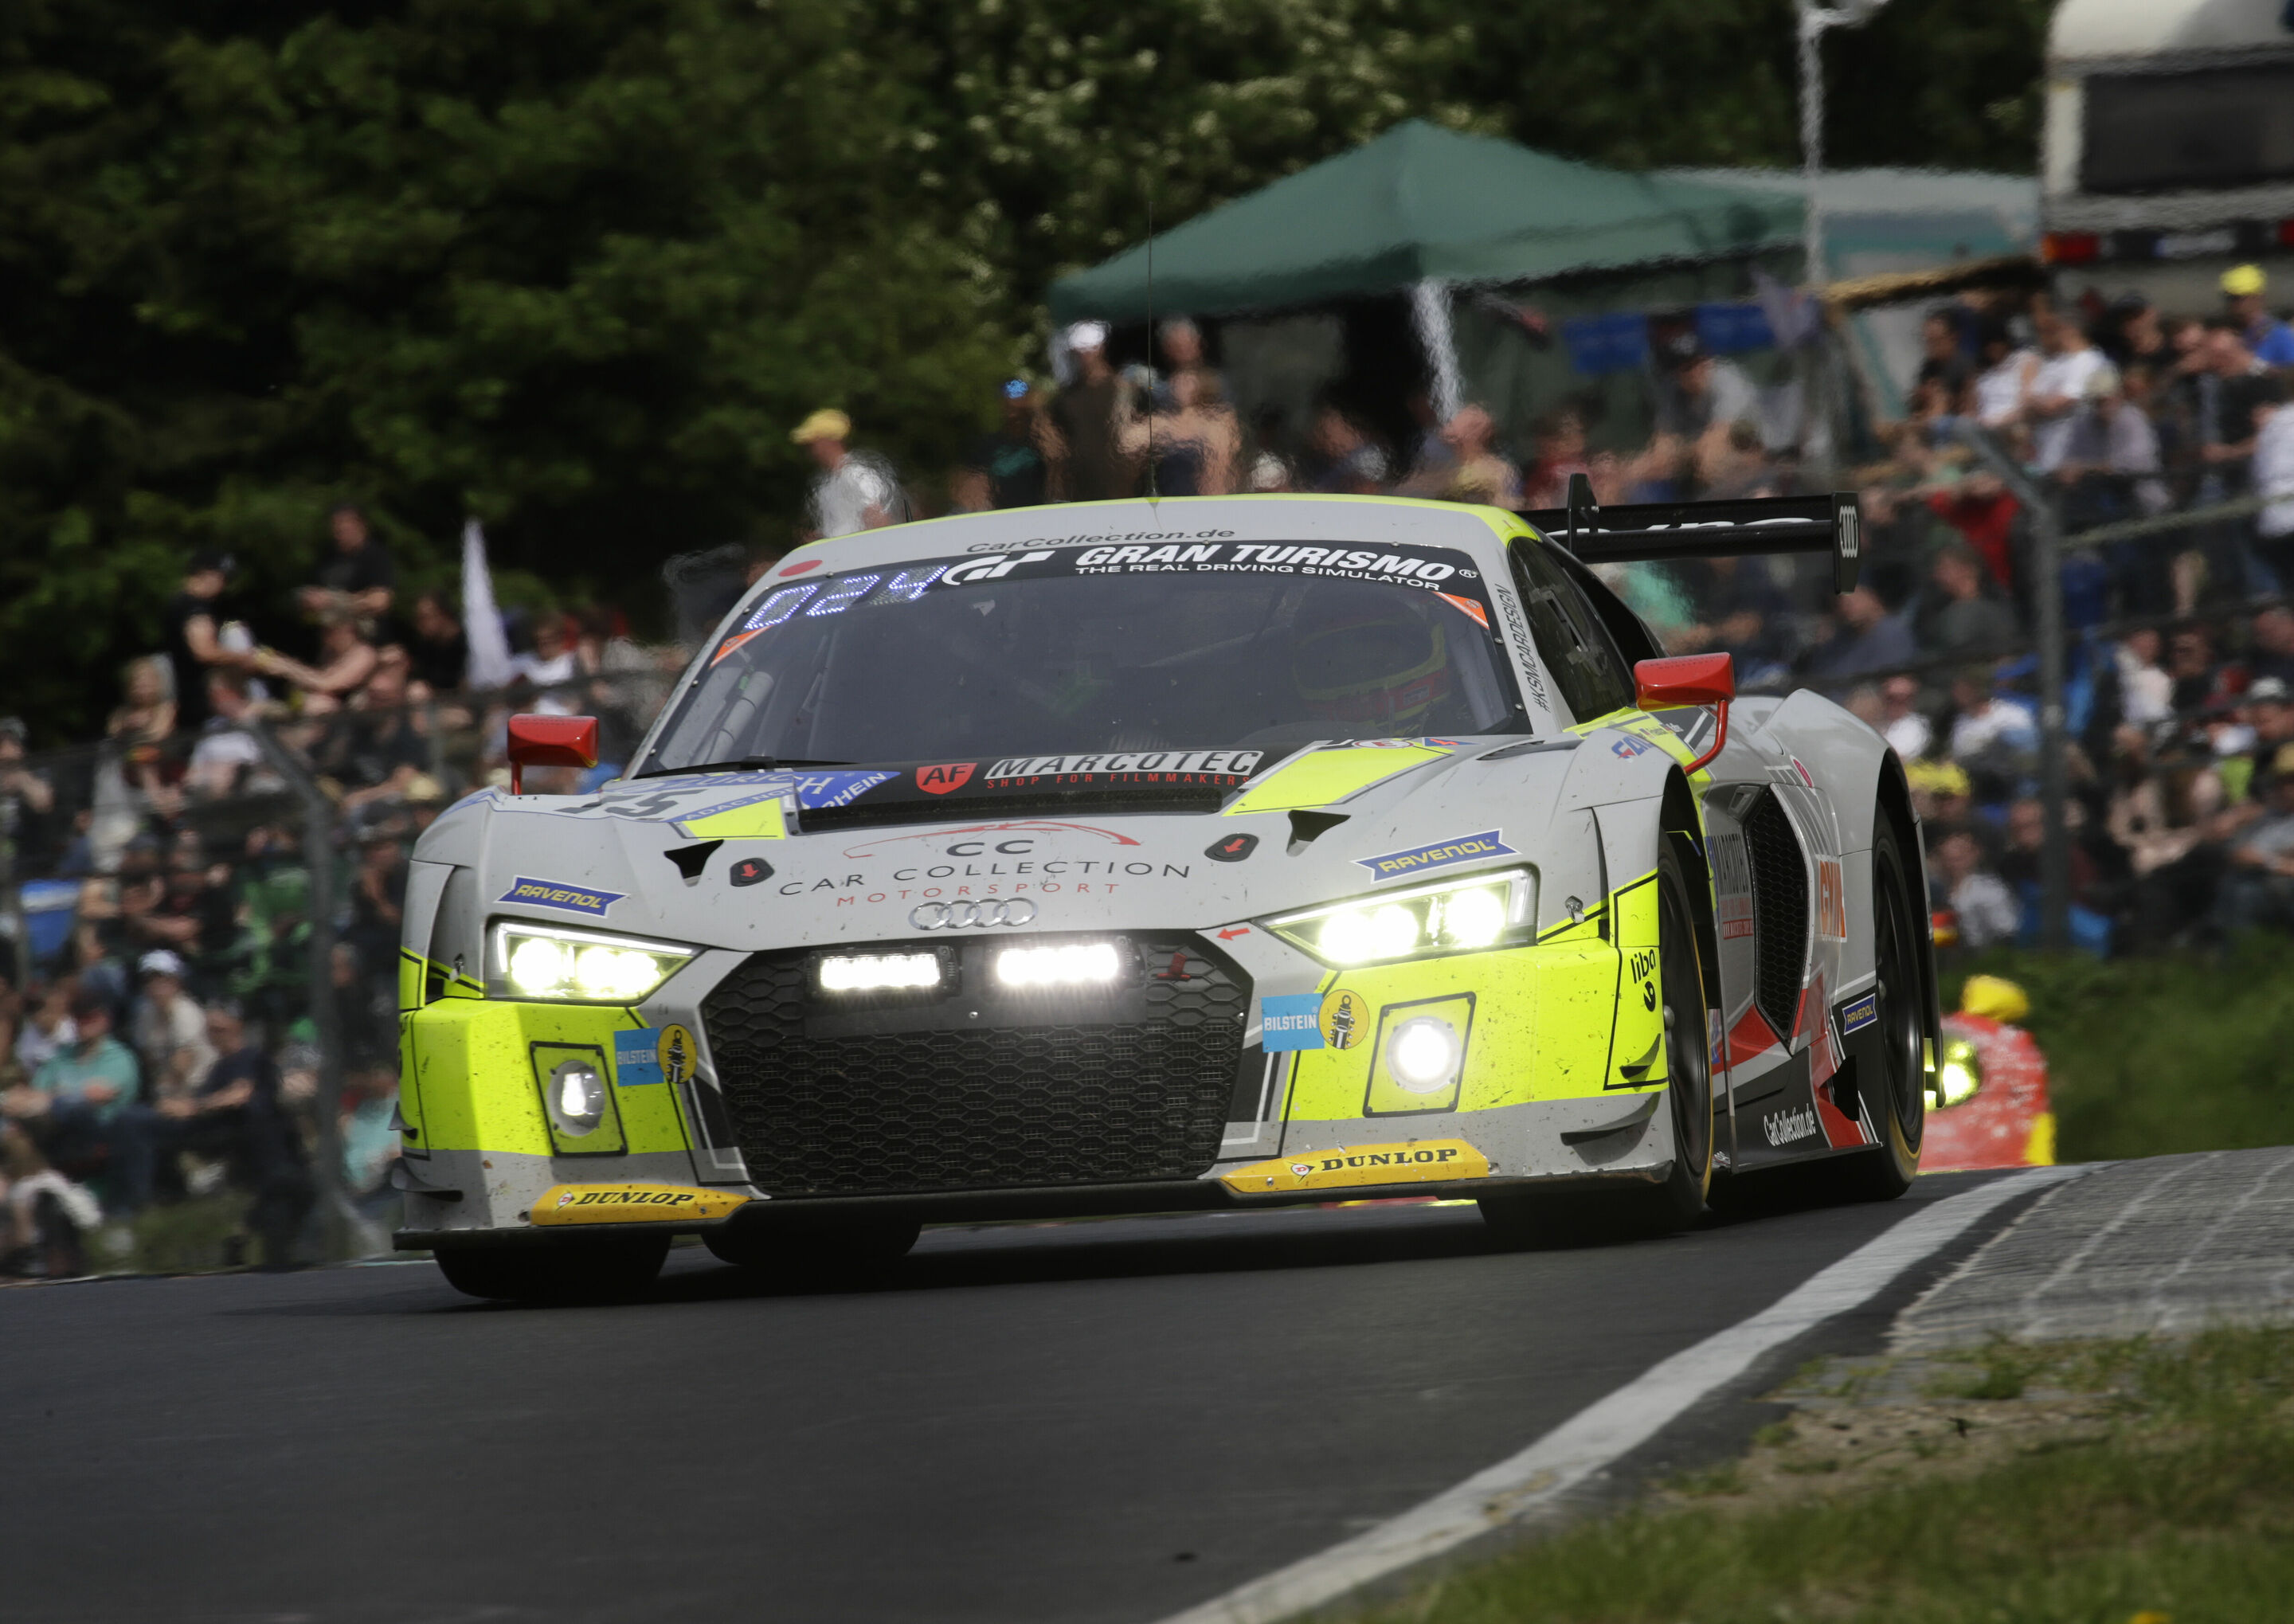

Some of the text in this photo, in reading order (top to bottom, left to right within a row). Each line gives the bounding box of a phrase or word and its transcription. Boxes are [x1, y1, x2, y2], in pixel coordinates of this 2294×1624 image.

[966, 529, 1235, 552] CarCollection.de
[1075, 545, 1455, 581] GRAN TURISMO
[1075, 563, 1441, 591] THE REAL DRIVING SIMULATOR
[922, 765, 969, 786] AF
[991, 751, 1260, 777] MARCOTEC
[987, 777, 1039, 789] SHOP
[1056, 774, 1093, 784] FOR
[686, 800, 747, 820] ADAC
[946, 840, 1035, 857] CC
[1379, 838, 1497, 872] RAVENOL
[779, 861, 1190, 896] CAR COLLECTION
[515, 883, 603, 910] RAVENOL
[836, 883, 1120, 907] MOTORSPORT
[1263, 1015, 1317, 1031] BILSTEIN
[1847, 1004, 1874, 1025] RAVENOL
[616, 1049, 658, 1066] BILSTEIN
[1764, 1103, 1817, 1147] CarCollection.de
[1321, 1148, 1458, 1172] DUNLOP
[578, 1189, 695, 1209] DUNLOP
